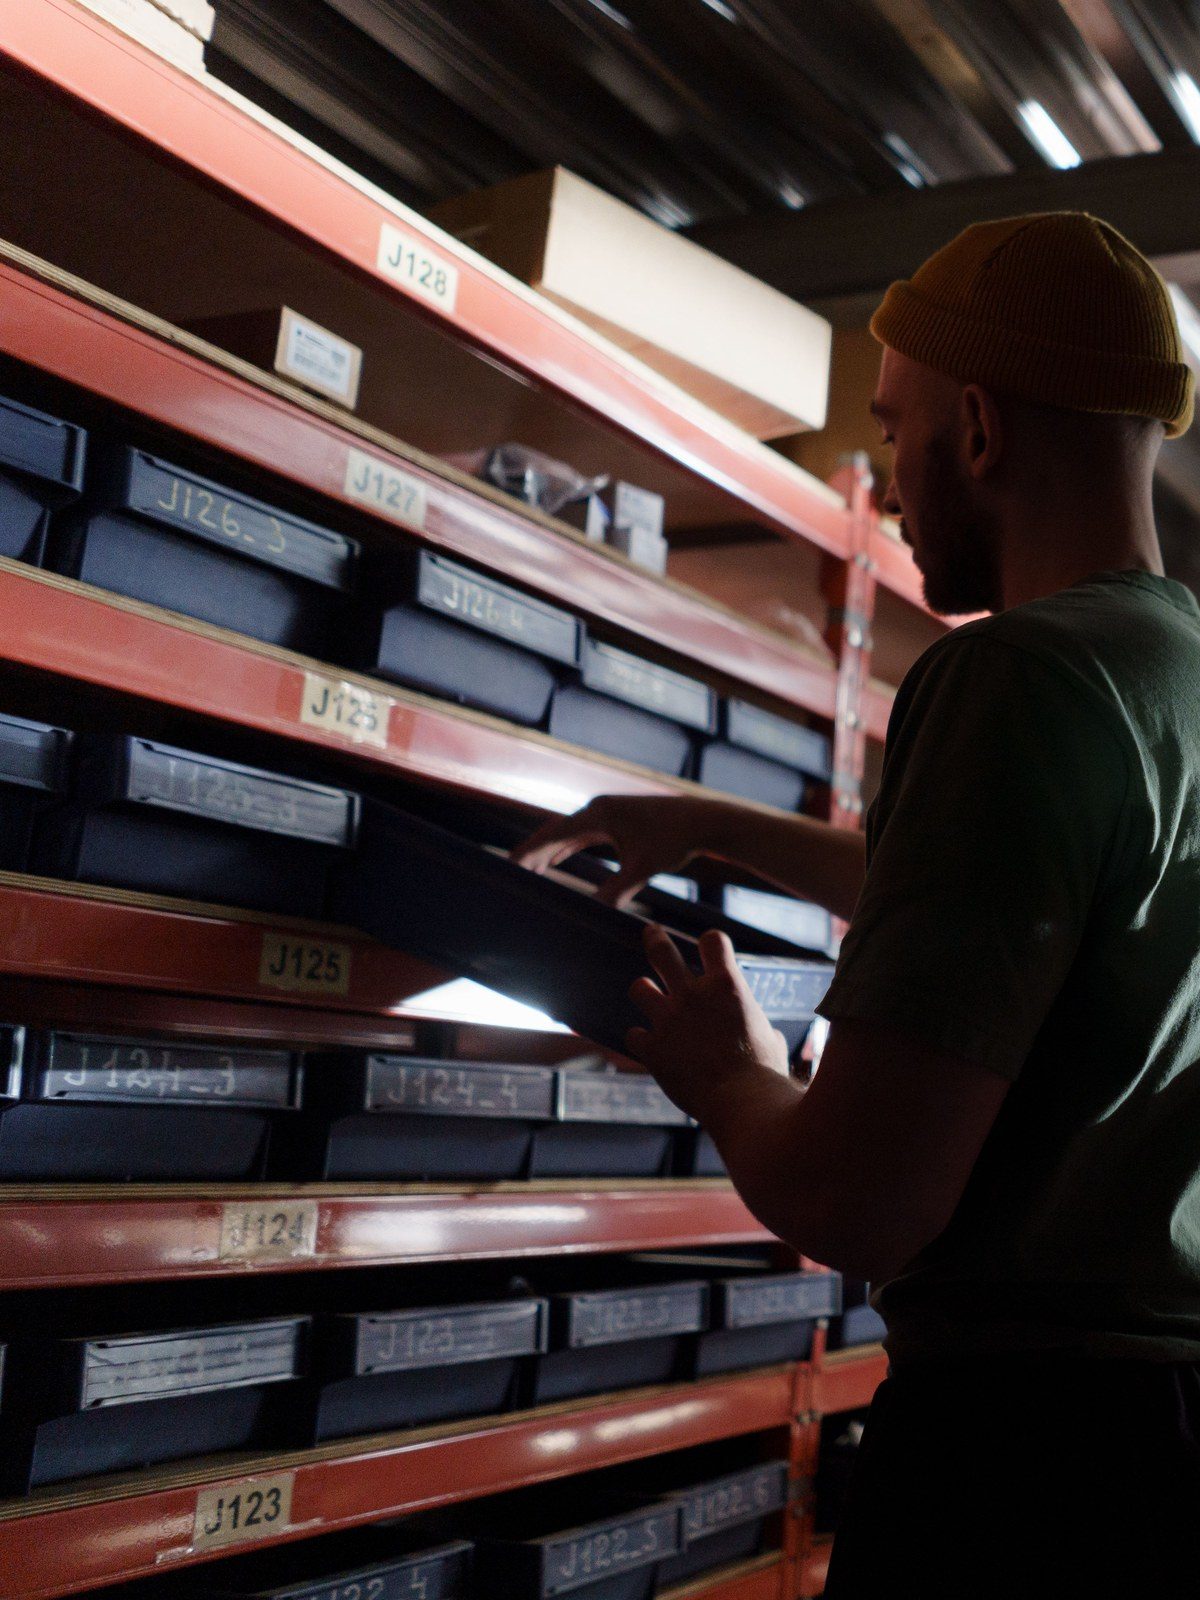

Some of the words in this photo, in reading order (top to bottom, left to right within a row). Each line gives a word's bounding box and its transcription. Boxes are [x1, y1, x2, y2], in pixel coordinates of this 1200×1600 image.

[387, 243, 448, 297] J128
[351, 463, 418, 514] J127
[269, 943, 341, 982] J125
[230, 1212, 305, 1247] J124
[204, 1487, 282, 1535] J123
